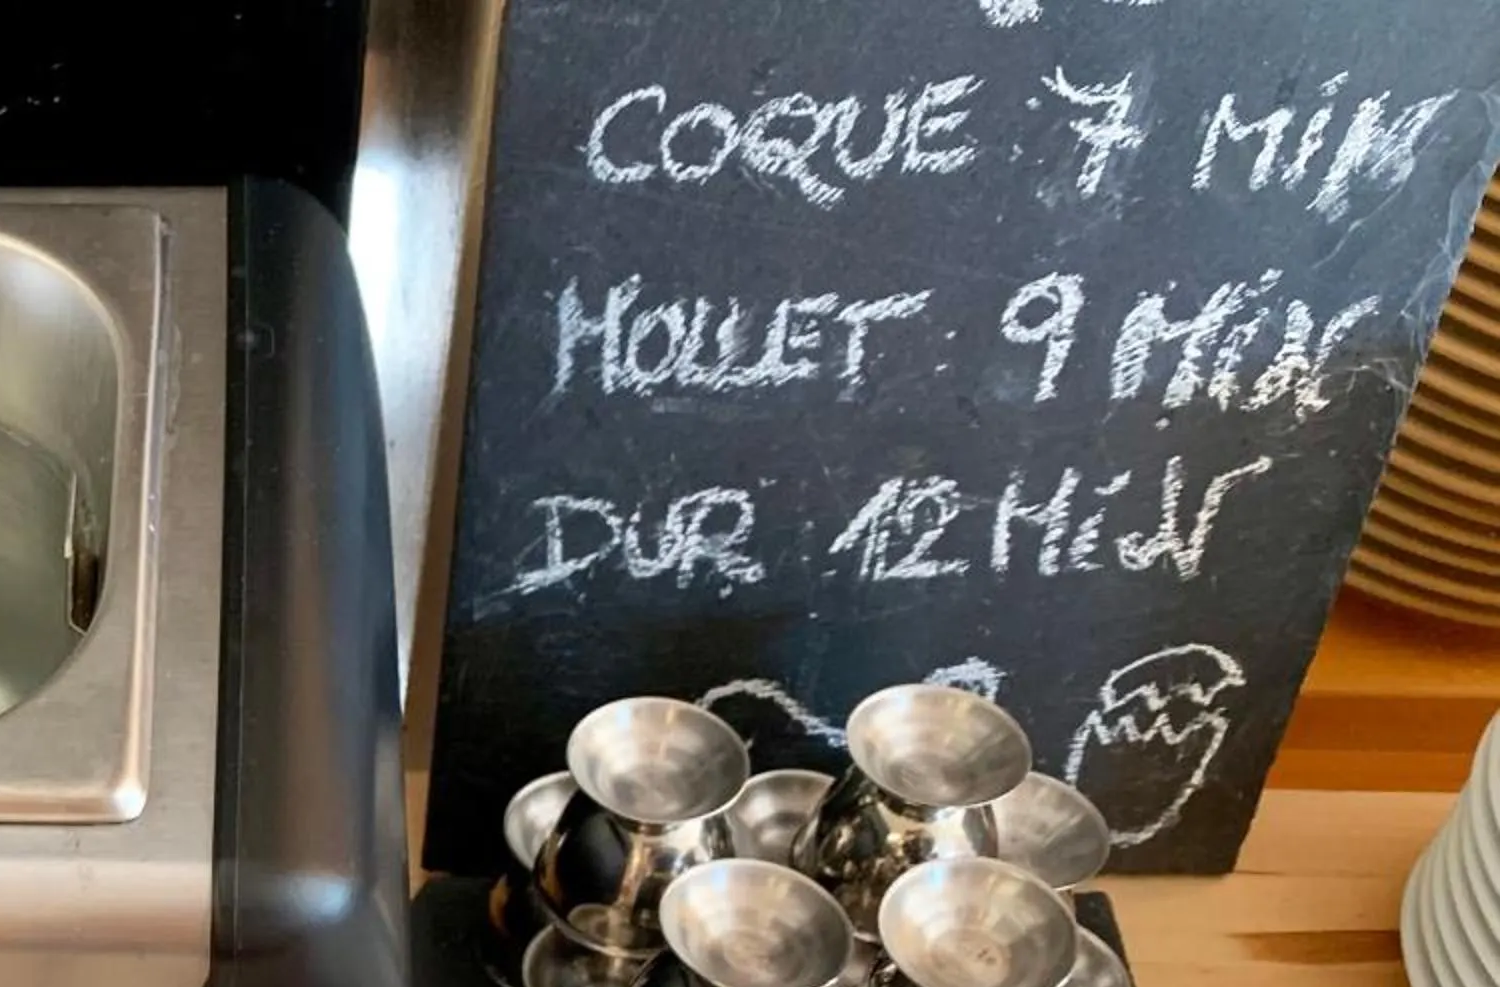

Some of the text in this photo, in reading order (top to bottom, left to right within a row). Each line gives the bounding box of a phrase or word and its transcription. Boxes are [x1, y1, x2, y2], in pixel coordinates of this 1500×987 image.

[584, 74, 985, 211] COQUE
[1041, 66, 1150, 200] 7
[1000, 272, 1086, 403] 9
[508, 485, 766, 598] DUR
[828, 475, 971, 580] 12
